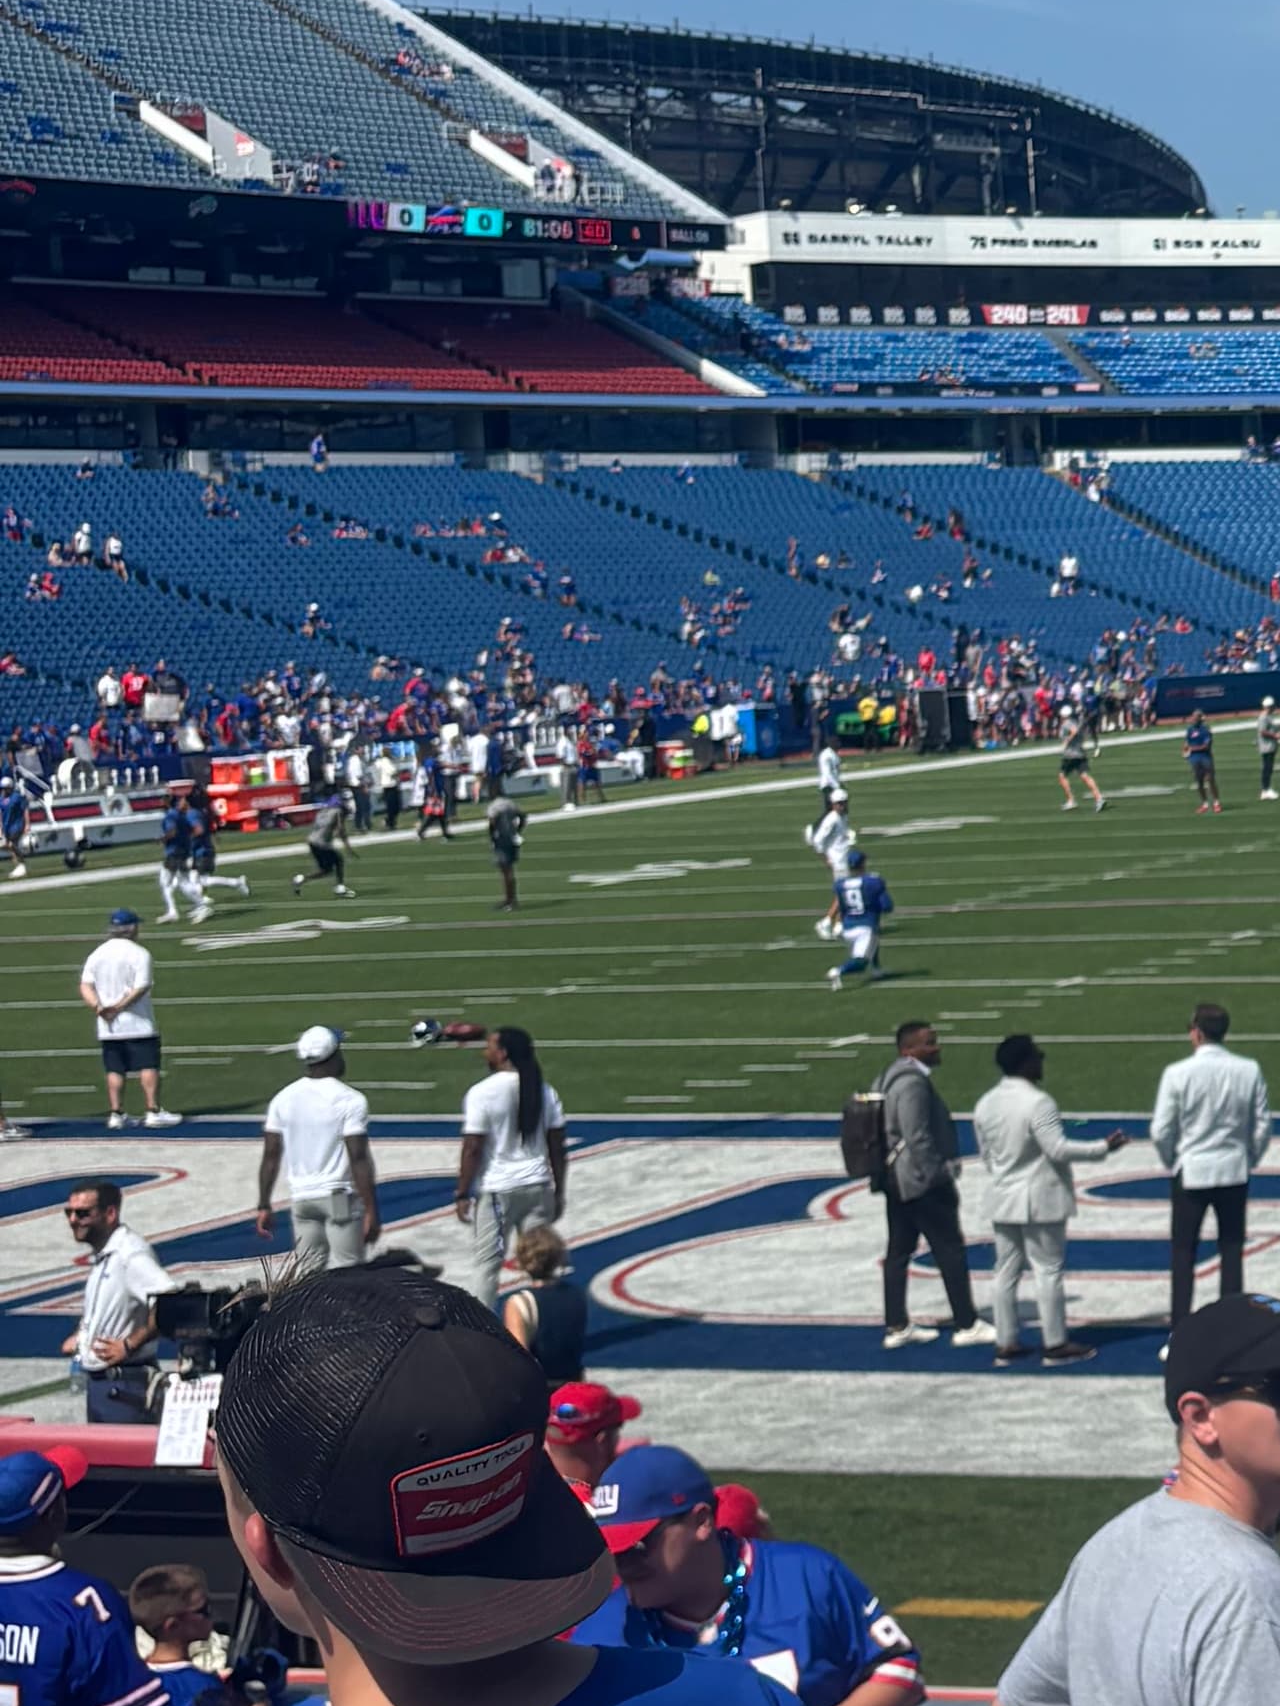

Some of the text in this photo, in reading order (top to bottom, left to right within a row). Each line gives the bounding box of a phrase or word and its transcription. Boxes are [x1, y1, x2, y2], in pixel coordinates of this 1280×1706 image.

[400, 208, 412, 227] 0
[478, 214, 493, 231] 0
[416, 1458, 490, 1487] QUALITY
